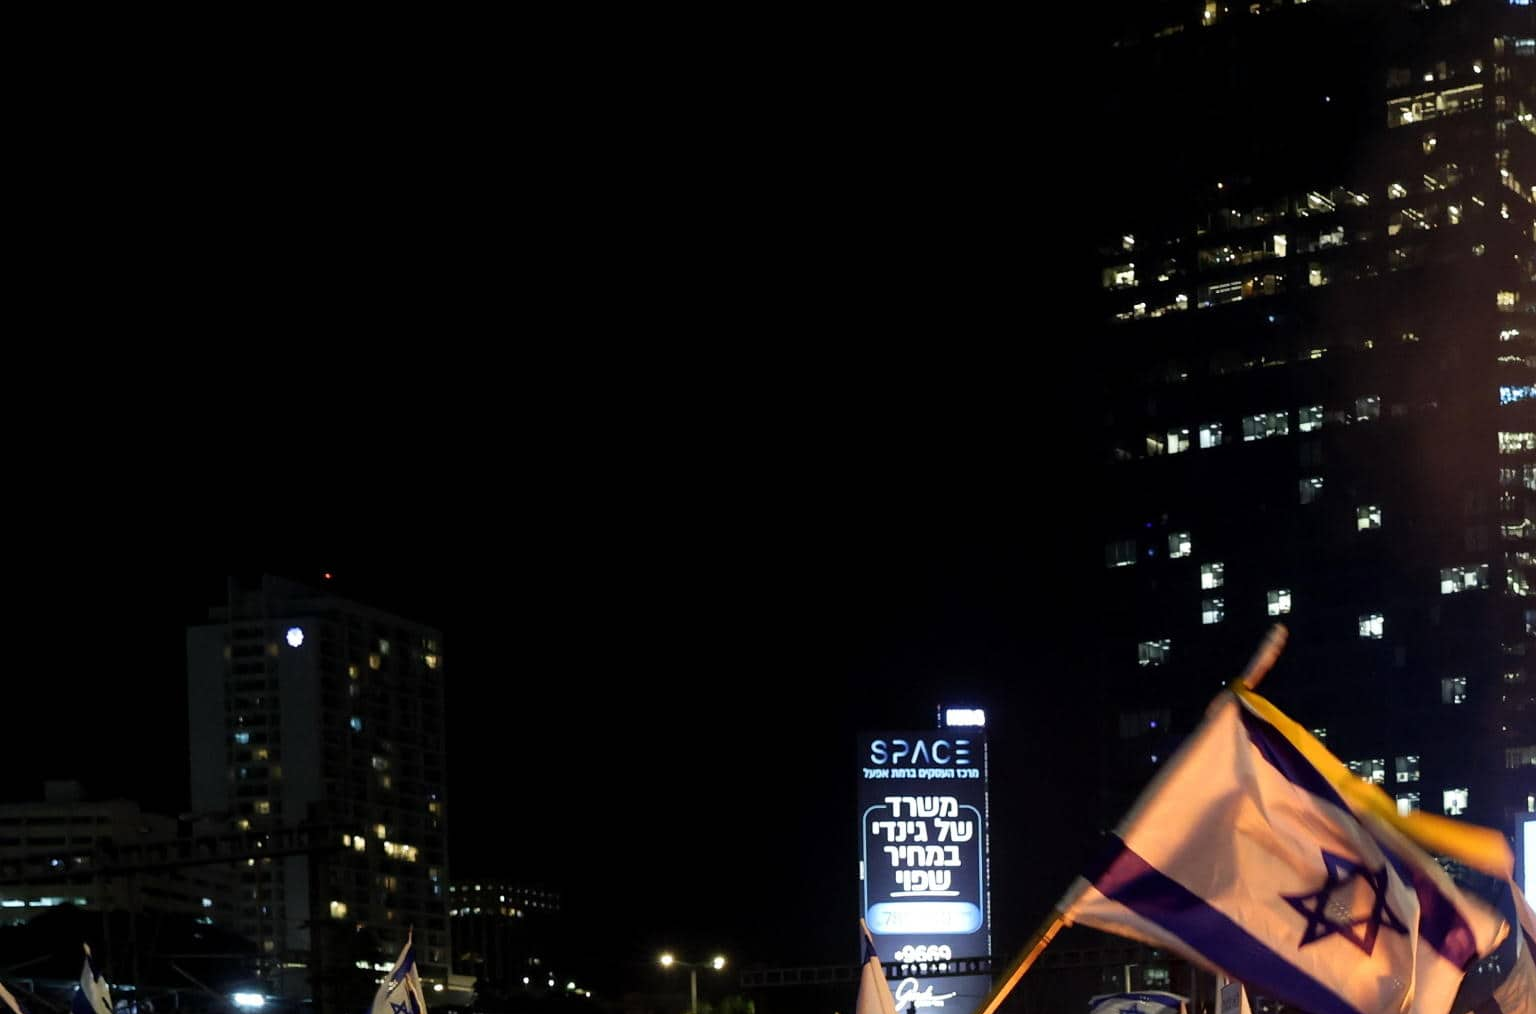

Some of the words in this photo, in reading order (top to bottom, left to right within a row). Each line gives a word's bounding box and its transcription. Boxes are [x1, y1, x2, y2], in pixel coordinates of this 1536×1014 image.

[871, 739, 971, 765] SPACE
[893, 768, 917, 778] ברמת
[919, 768, 955, 779] העסקים
[956, 768, 980, 778] מרכז
[885, 796, 959, 818] משרד
[872, 820, 928, 842] גינדי
[935, 818, 973, 842] של
[884, 845, 961, 867] במחיר
[895, 870, 951, 892] שפוי
